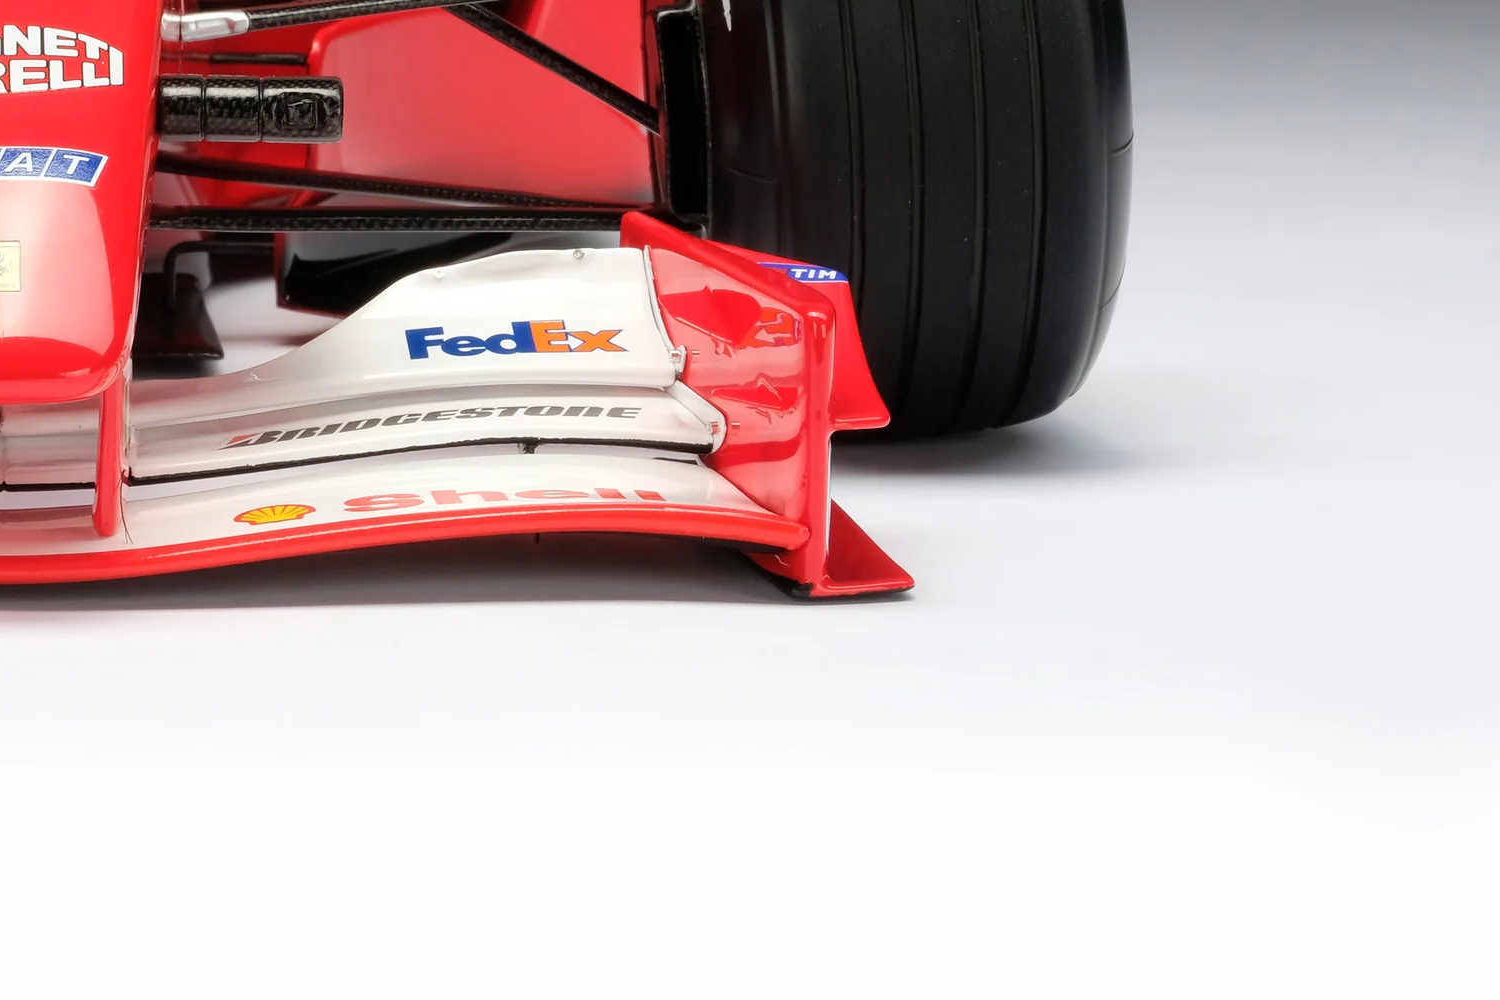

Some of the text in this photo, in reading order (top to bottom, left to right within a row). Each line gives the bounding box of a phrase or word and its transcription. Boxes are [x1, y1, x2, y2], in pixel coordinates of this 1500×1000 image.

[791, 268, 837, 280] TIM
[405, 319, 629, 360] FedEx
[219, 405, 642, 450] BRIDGESTONE
[343, 487, 668, 513] Shell
